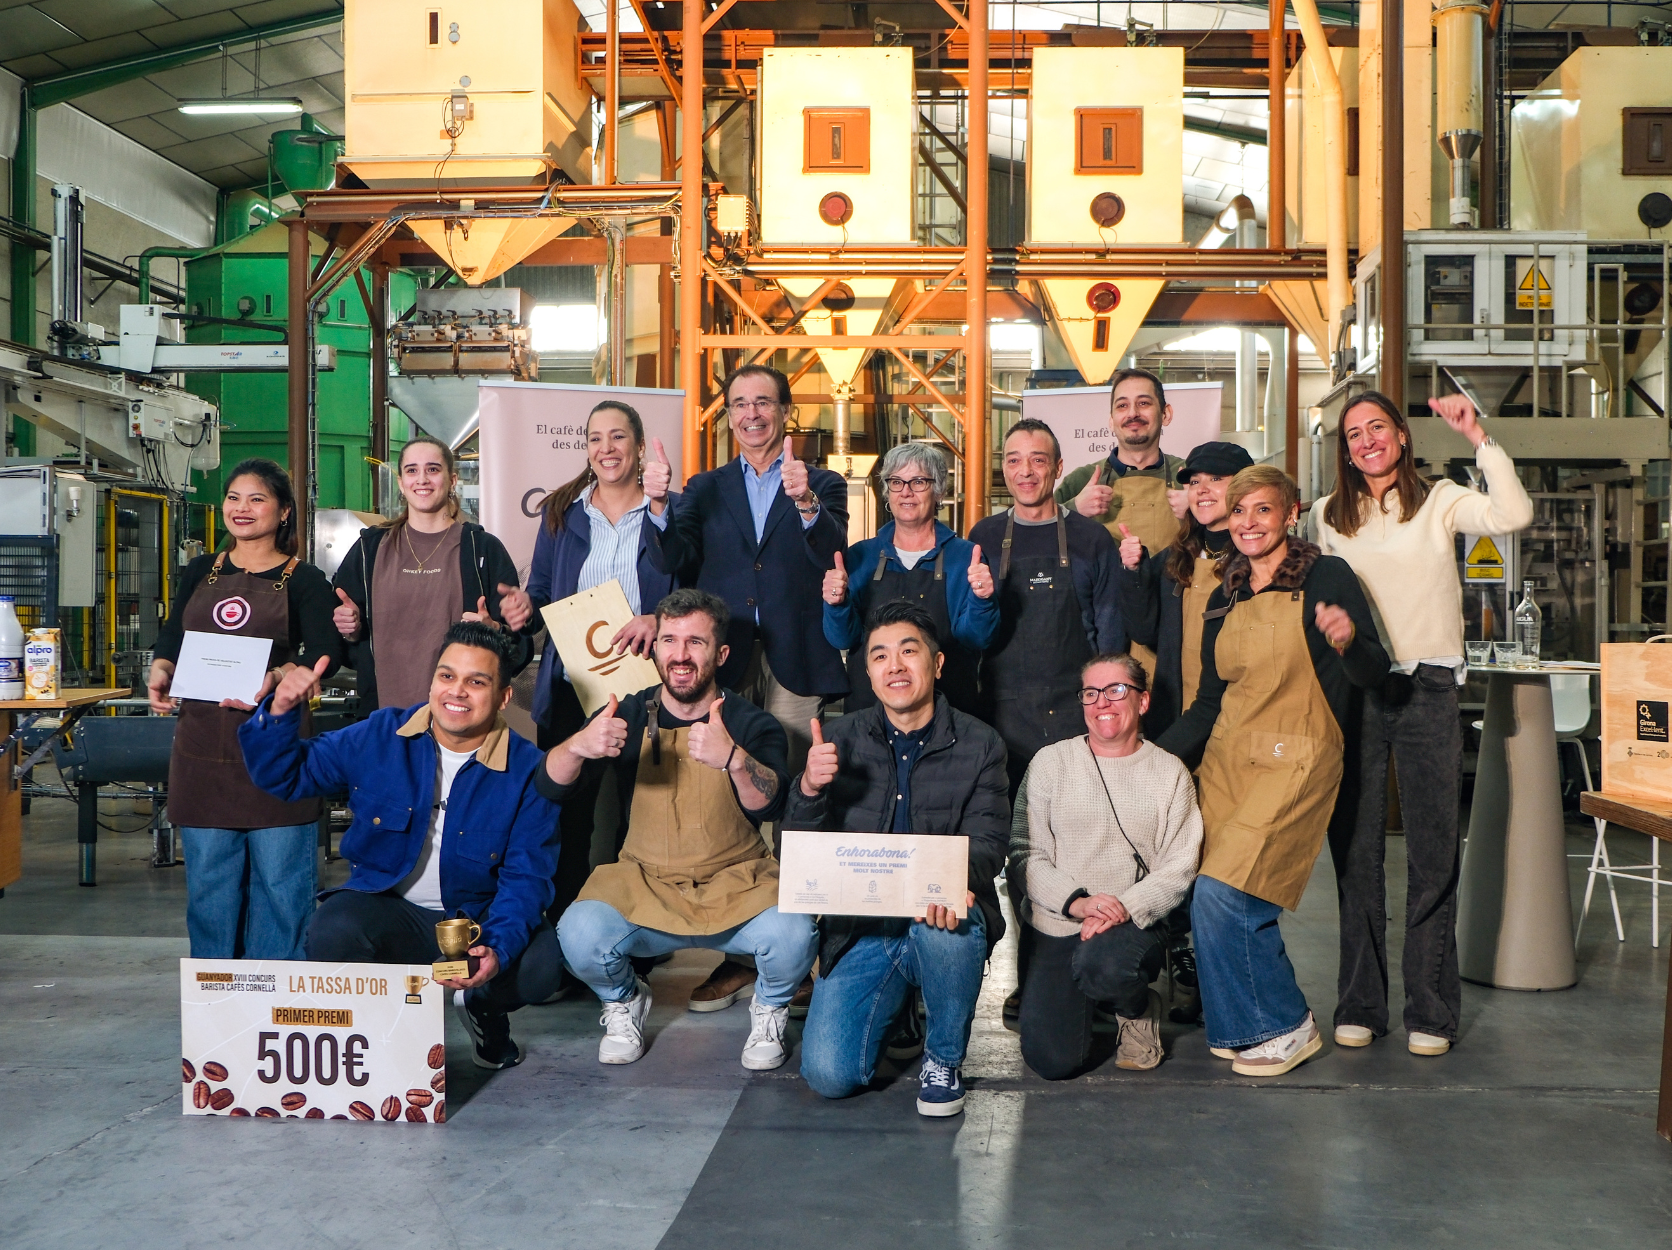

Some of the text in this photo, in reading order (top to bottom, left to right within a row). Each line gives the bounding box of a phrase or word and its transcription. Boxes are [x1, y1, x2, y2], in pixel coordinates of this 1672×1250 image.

[537, 425, 548, 435] El
[550, 425, 574, 436] cafè
[1074, 428, 1085, 438] El
[1087, 427, 1109, 438] cafè
[552, 439, 571, 450] des
[1088, 442, 1107, 453] des
[27, 645, 52, 655] alpro
[836, 846, 916, 859] Enhorabona!
[197, 973, 276, 983] GUANYADOR XVIII CONCURS
[201, 982, 276, 993] BARISTA CAFÈS CORNELLÀ
[289, 975, 388, 996] LA TASSA D'OR
[276, 1008, 349, 1025] PRIMER PREMI
[257, 1031, 370, 1088] 500€
